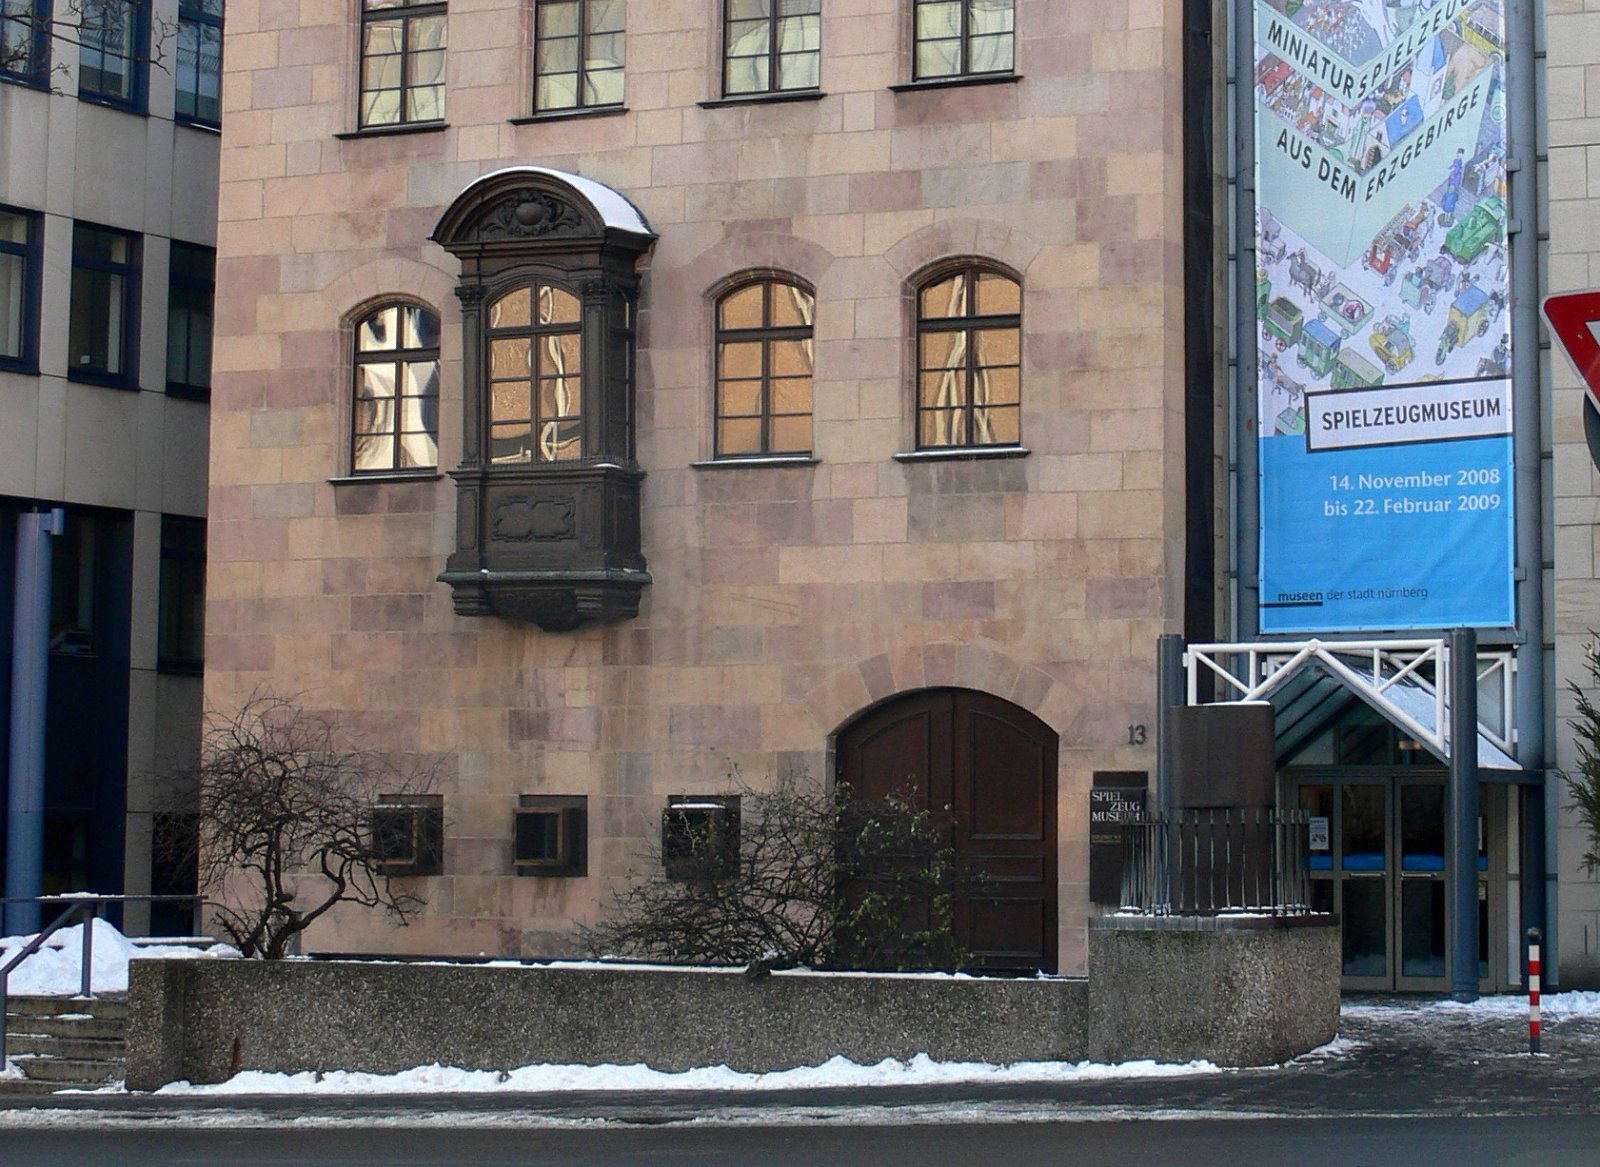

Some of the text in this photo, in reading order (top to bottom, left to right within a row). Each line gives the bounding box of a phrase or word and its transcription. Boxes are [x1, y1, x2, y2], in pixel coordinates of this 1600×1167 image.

[1276, 84, 1481, 203] AUS DEM ERZGEBIRGE
[1322, 397, 1501, 431] SPIELZEUGMUSEUM
[1330, 468, 1501, 491] 14. November 2008
[1324, 494, 1501, 517] bis 22. Februar 2009
[1278, 586, 1428, 601] museen der stadt nürnberg
[1127, 724, 1147, 745] 13
[1092, 791, 1123, 802] SPIEL
[1110, 801, 1140, 812] ZEUG
